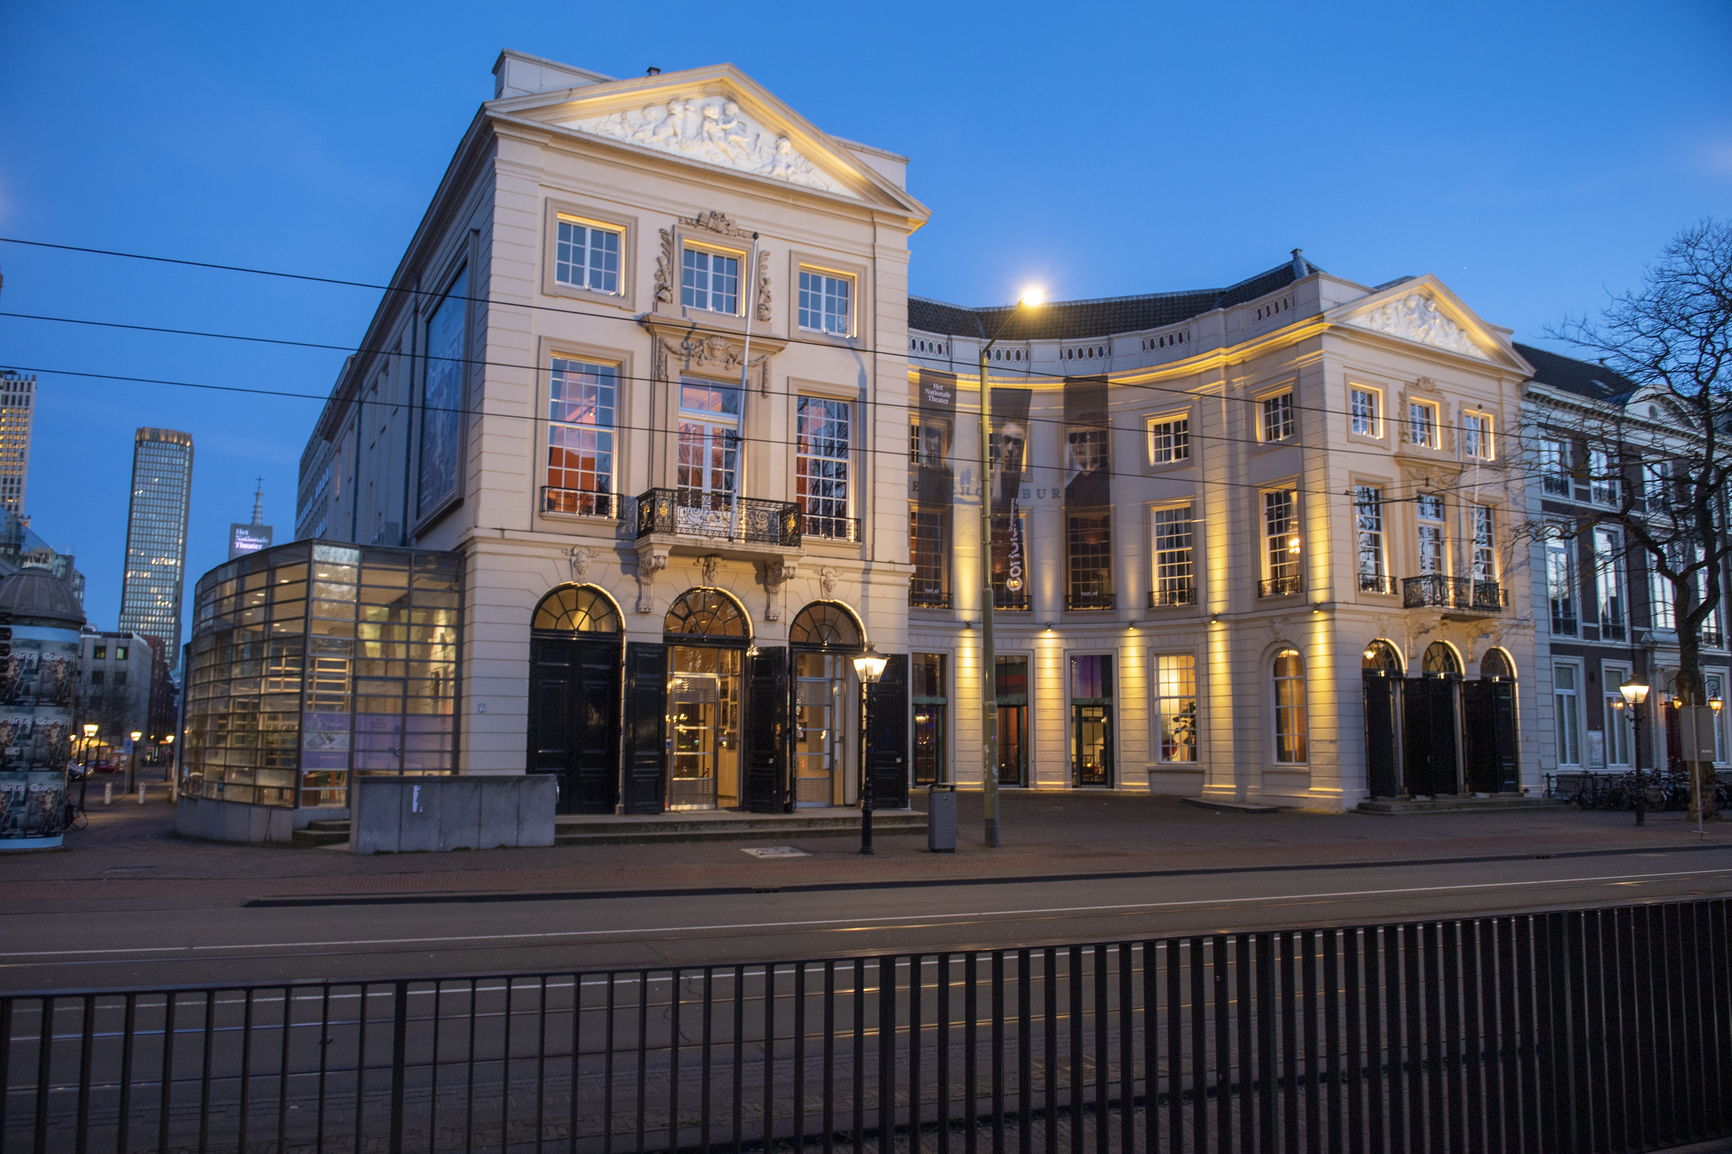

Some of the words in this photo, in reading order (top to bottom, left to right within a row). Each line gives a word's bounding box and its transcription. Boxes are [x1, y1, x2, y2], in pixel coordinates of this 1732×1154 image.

[933, 383, 944, 391] Het
[925, 388, 952, 398] Nationale
[928, 395, 949, 405] Theater
[235, 541, 263, 550] Theater
